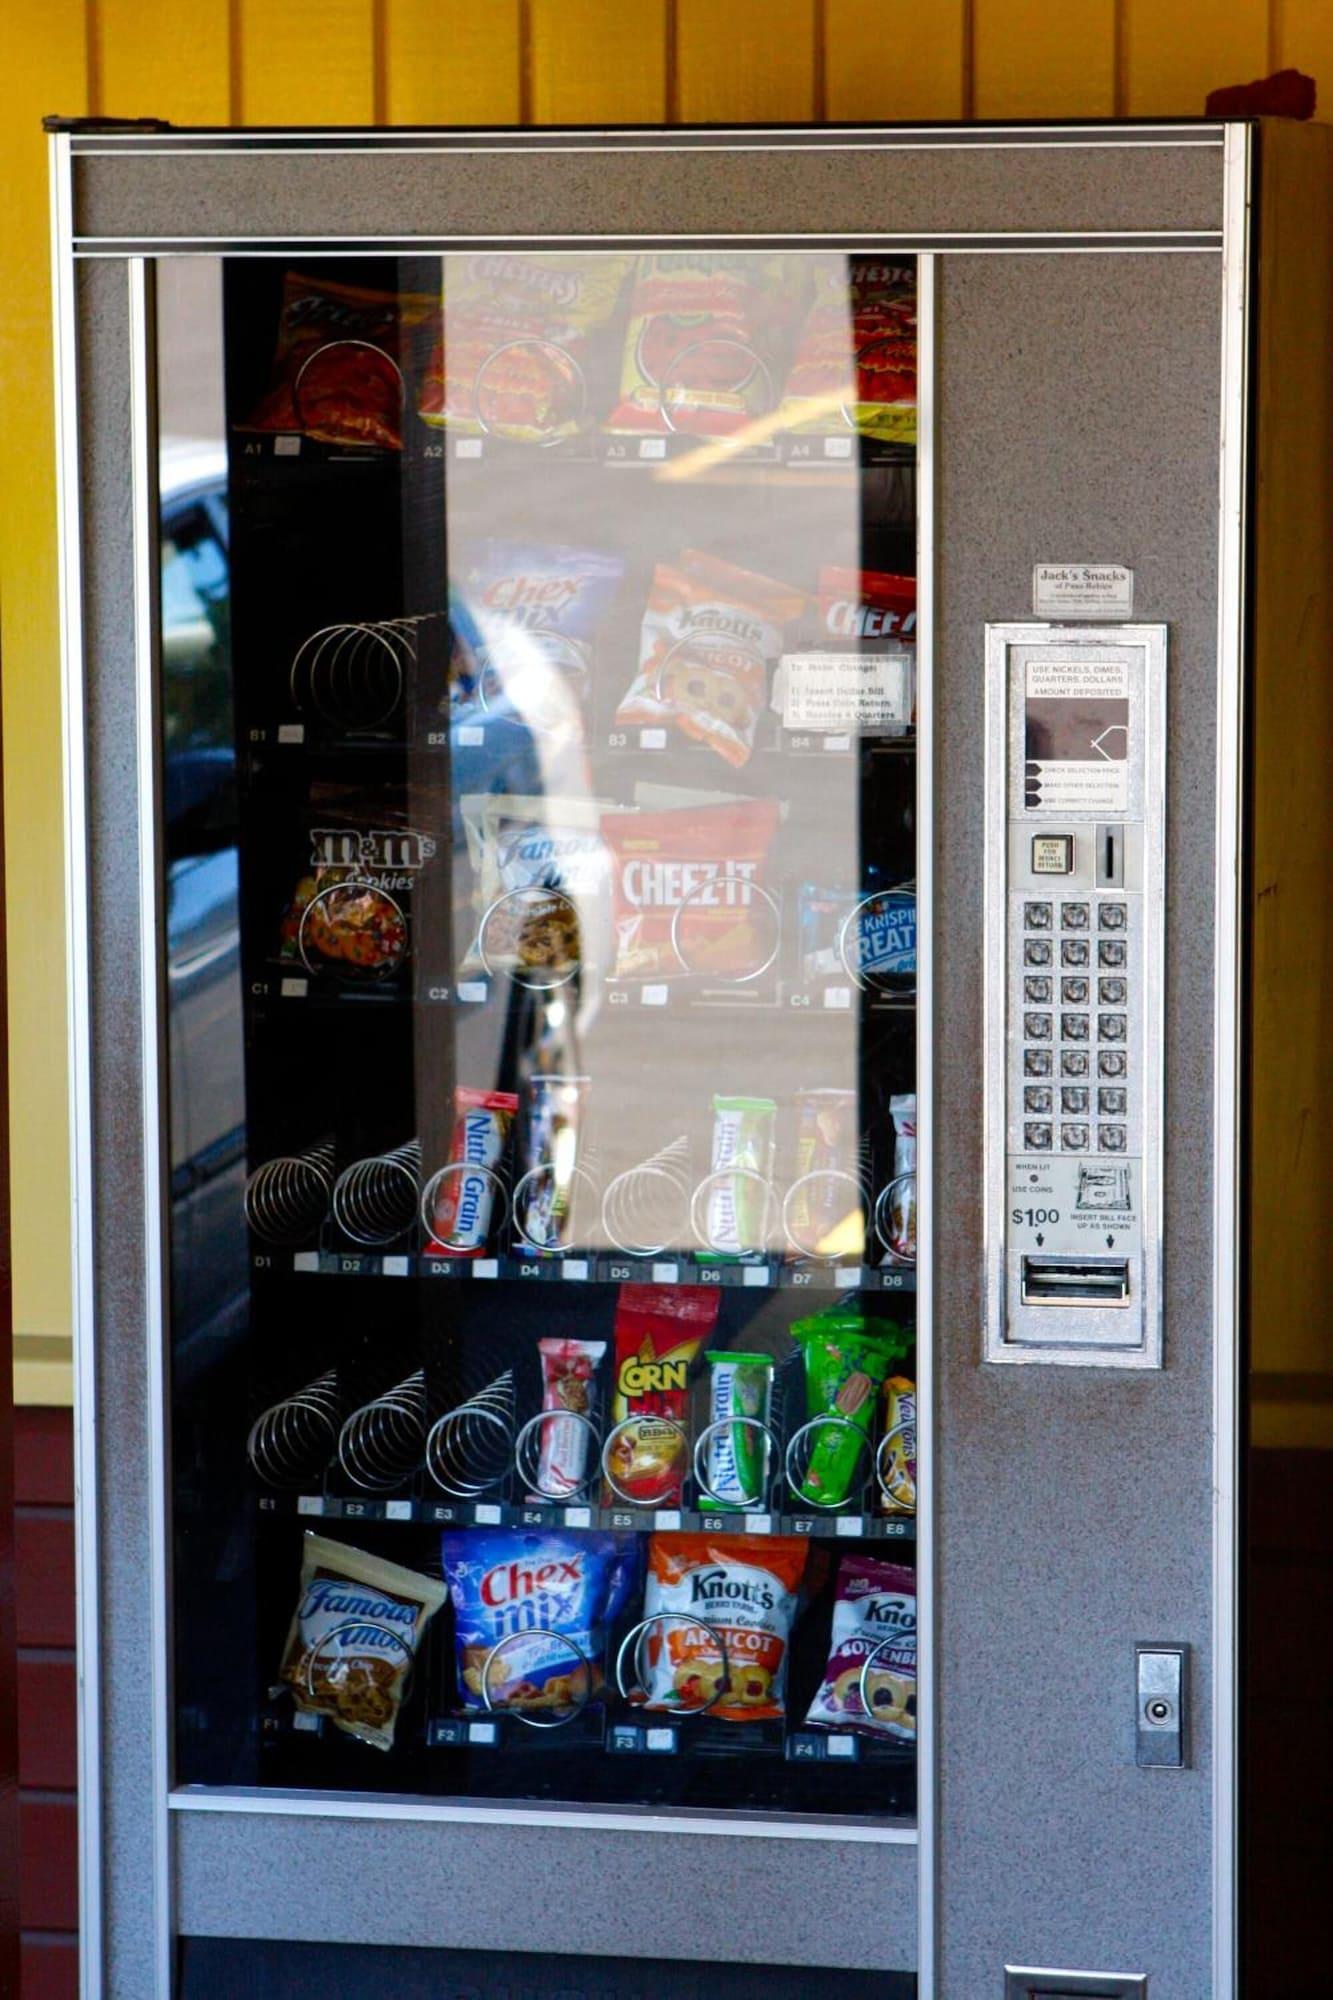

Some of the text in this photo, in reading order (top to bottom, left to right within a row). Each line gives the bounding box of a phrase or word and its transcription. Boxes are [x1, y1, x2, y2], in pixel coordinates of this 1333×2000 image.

[244, 444, 262, 455] A1
[423, 446, 442, 458] A2
[1040, 568, 1127, 580] Jack's Snacks
[482, 574, 583, 608] Chex
[1082, 675, 1123, 684] DOLLARS
[1034, 688, 1122, 696] AMOUNT DEPOSITED
[250, 730, 266, 742] B1
[428, 732, 446, 745] B2
[608, 734, 626, 747] B3
[430, 988, 449, 1000] C2
[458, 1114, 492, 1232] Nutr Grain
[1028, 1186, 1054, 1194] COINS
[1070, 1214, 1098, 1222] INSERT
[255, 1256, 272, 1268] D1
[342, 1260, 360, 1272] D2
[431, 1262, 450, 1274] D3
[520, 1264, 540, 1277] D4
[610, 1266, 630, 1280] D5
[701, 1270, 721, 1282] D6
[792, 1272, 814, 1285] D7
[883, 1274, 903, 1287] D8
[617, 1354, 688, 1398] CORN
[346, 1504, 364, 1516] E2
[435, 1508, 453, 1520] E3
[524, 1512, 542, 1524] E4
[614, 1515, 632, 1527] E5
[704, 1518, 723, 1530] E6
[795, 1521, 814, 1532] E7
[886, 1524, 906, 1536] E8
[480, 1553, 585, 1608] Chex
[691, 1570, 774, 1610] Knott's
[298, 1580, 418, 1625] Famous
[494, 1583, 578, 1638] mix
[437, 1730, 455, 1741] F2
[615, 1737, 634, 1748] F3
[796, 1744, 813, 1756] F4
